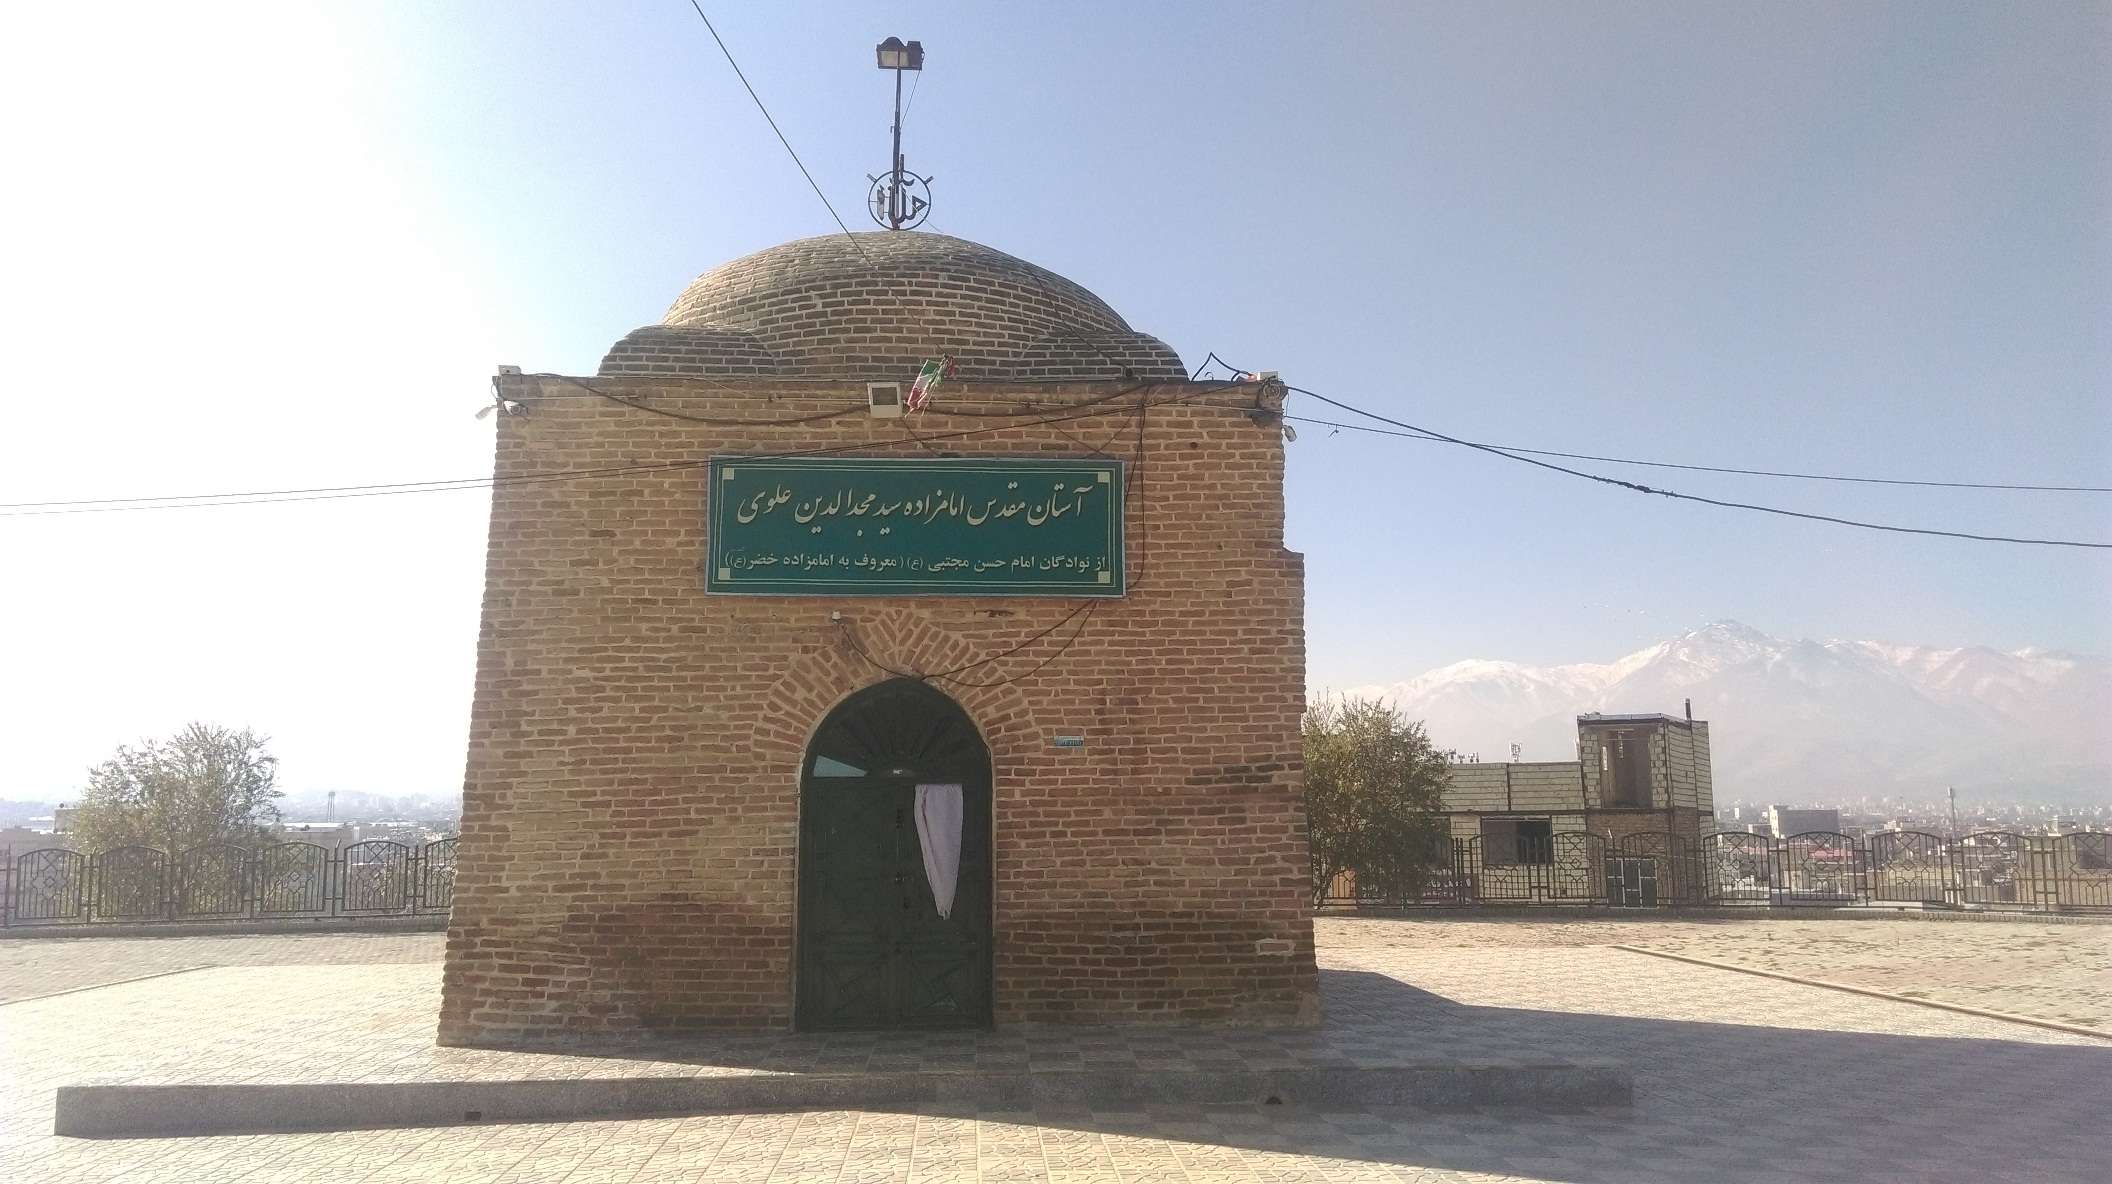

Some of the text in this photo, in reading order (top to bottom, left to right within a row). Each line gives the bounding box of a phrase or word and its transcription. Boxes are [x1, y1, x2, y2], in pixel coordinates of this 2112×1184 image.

[737, 484, 792, 524] علوی
[903, 489, 965, 526] امامزاده
[966, 481, 1026, 526] مقدس
[1027, 483, 1094, 526] آستان
[872, 499, 903, 536] سید
[783, 553, 834, 570] امامزاده
[838, 554, 850, 570] به
[928, 556, 970, 572] مجتبی
[974, 558, 1006, 573] حسن
[1011, 555, 1035, 573] امام
[1039, 555, 1090, 573] نوادگان
[1093, 555, 1106, 571] از
